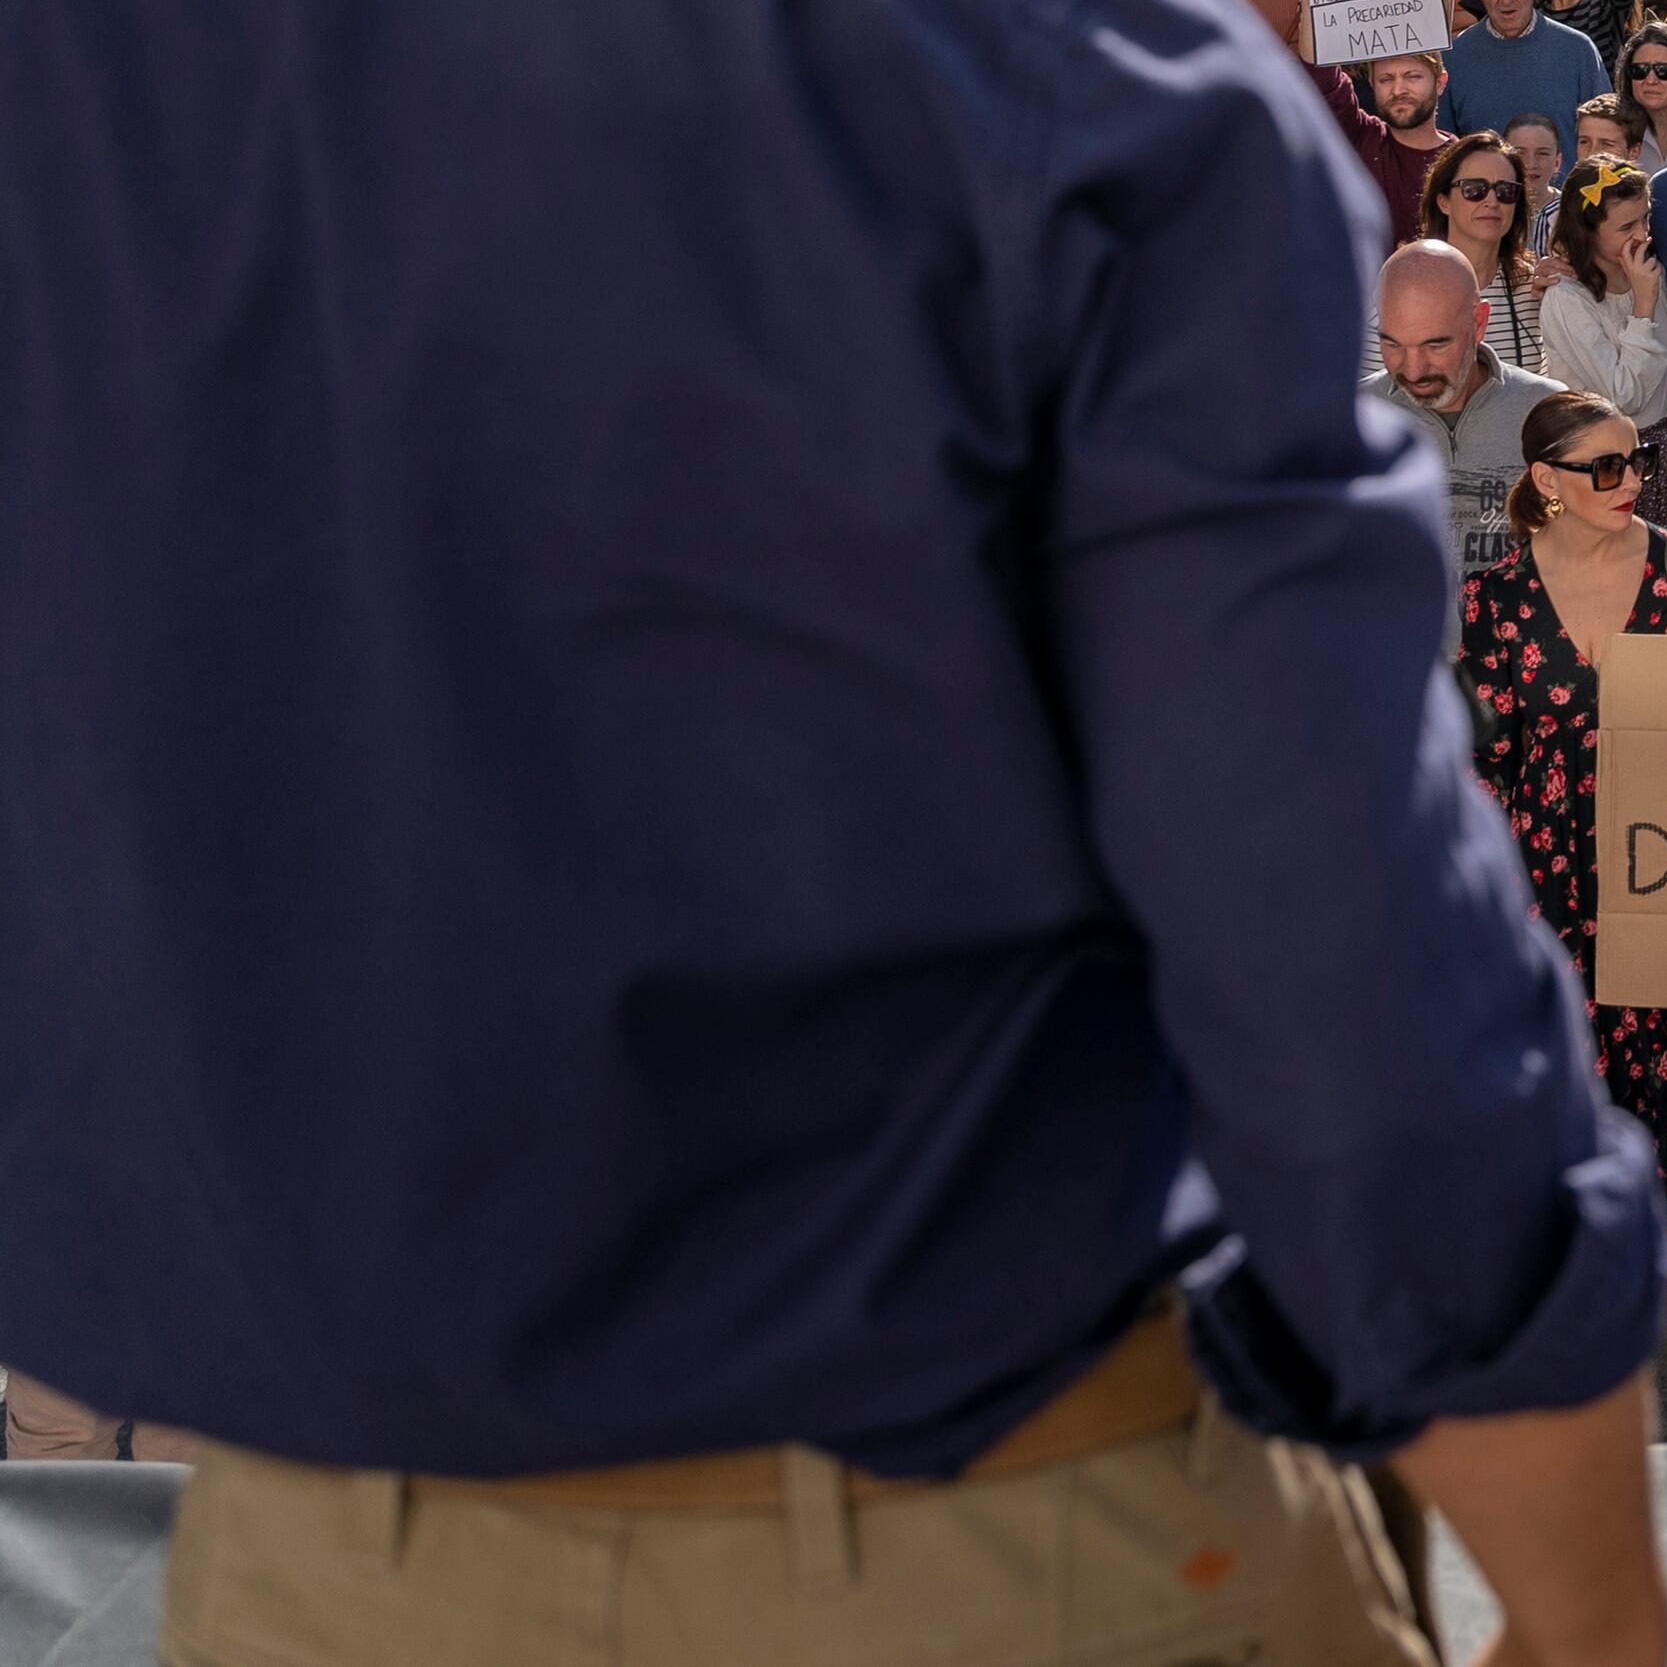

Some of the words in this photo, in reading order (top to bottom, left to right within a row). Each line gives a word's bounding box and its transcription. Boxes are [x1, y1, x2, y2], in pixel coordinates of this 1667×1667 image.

[1322, 12, 1338, 28] LA
[1347, 0, 1424, 25] PRECARIEDAD
[1348, 23, 1424, 58] MATA
